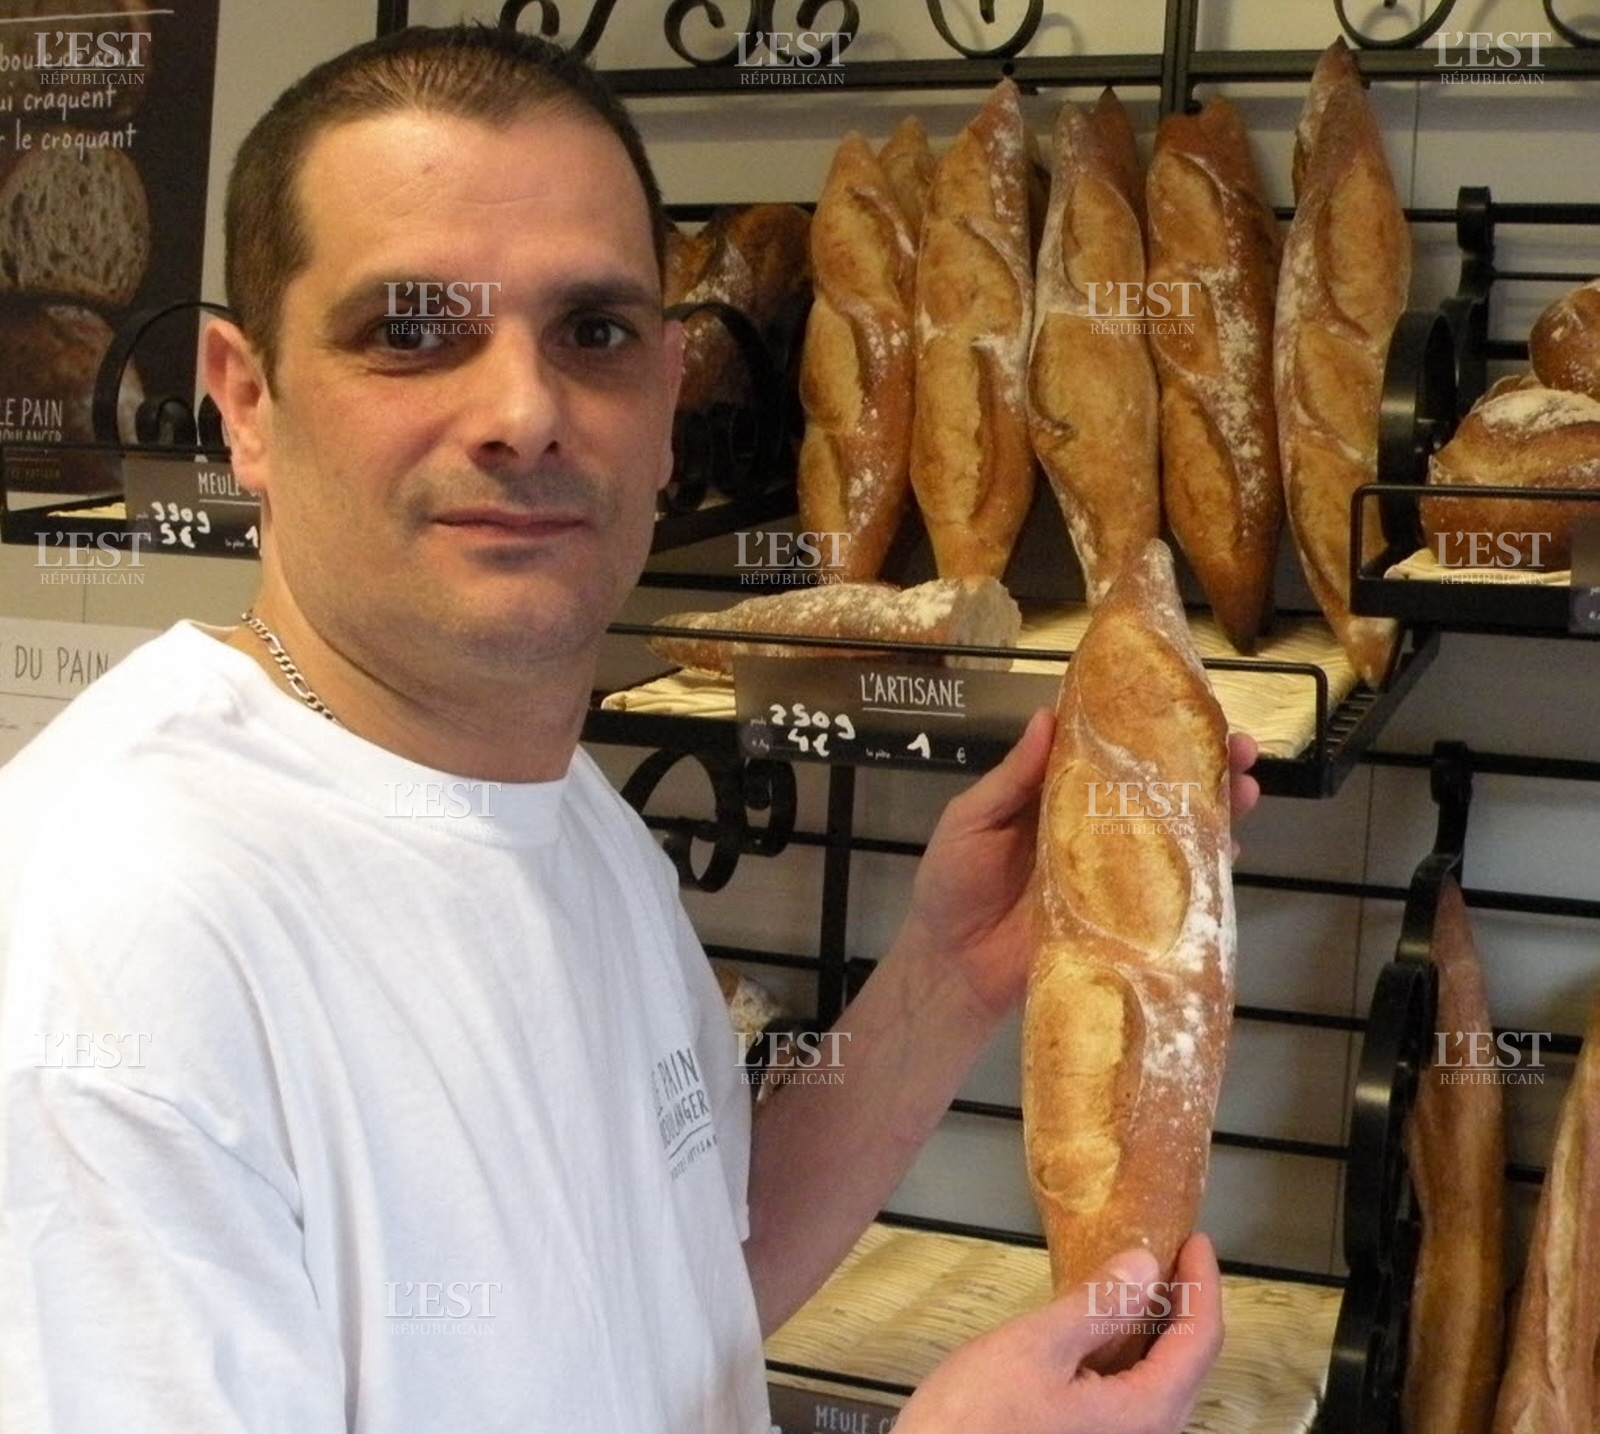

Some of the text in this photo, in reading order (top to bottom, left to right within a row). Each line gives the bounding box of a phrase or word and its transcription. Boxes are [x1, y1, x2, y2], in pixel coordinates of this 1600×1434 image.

[24, 84, 117, 121] craquent
[16, 118, 137, 161] le croquant
[21, 397, 63, 427] PAIN
[14, 644, 110, 685] DU PAIN
[860, 671, 966, 708] L'ARTISANE
[657, 1047, 700, 1101] PAIN
[815, 1404, 870, 1434] MEULE
